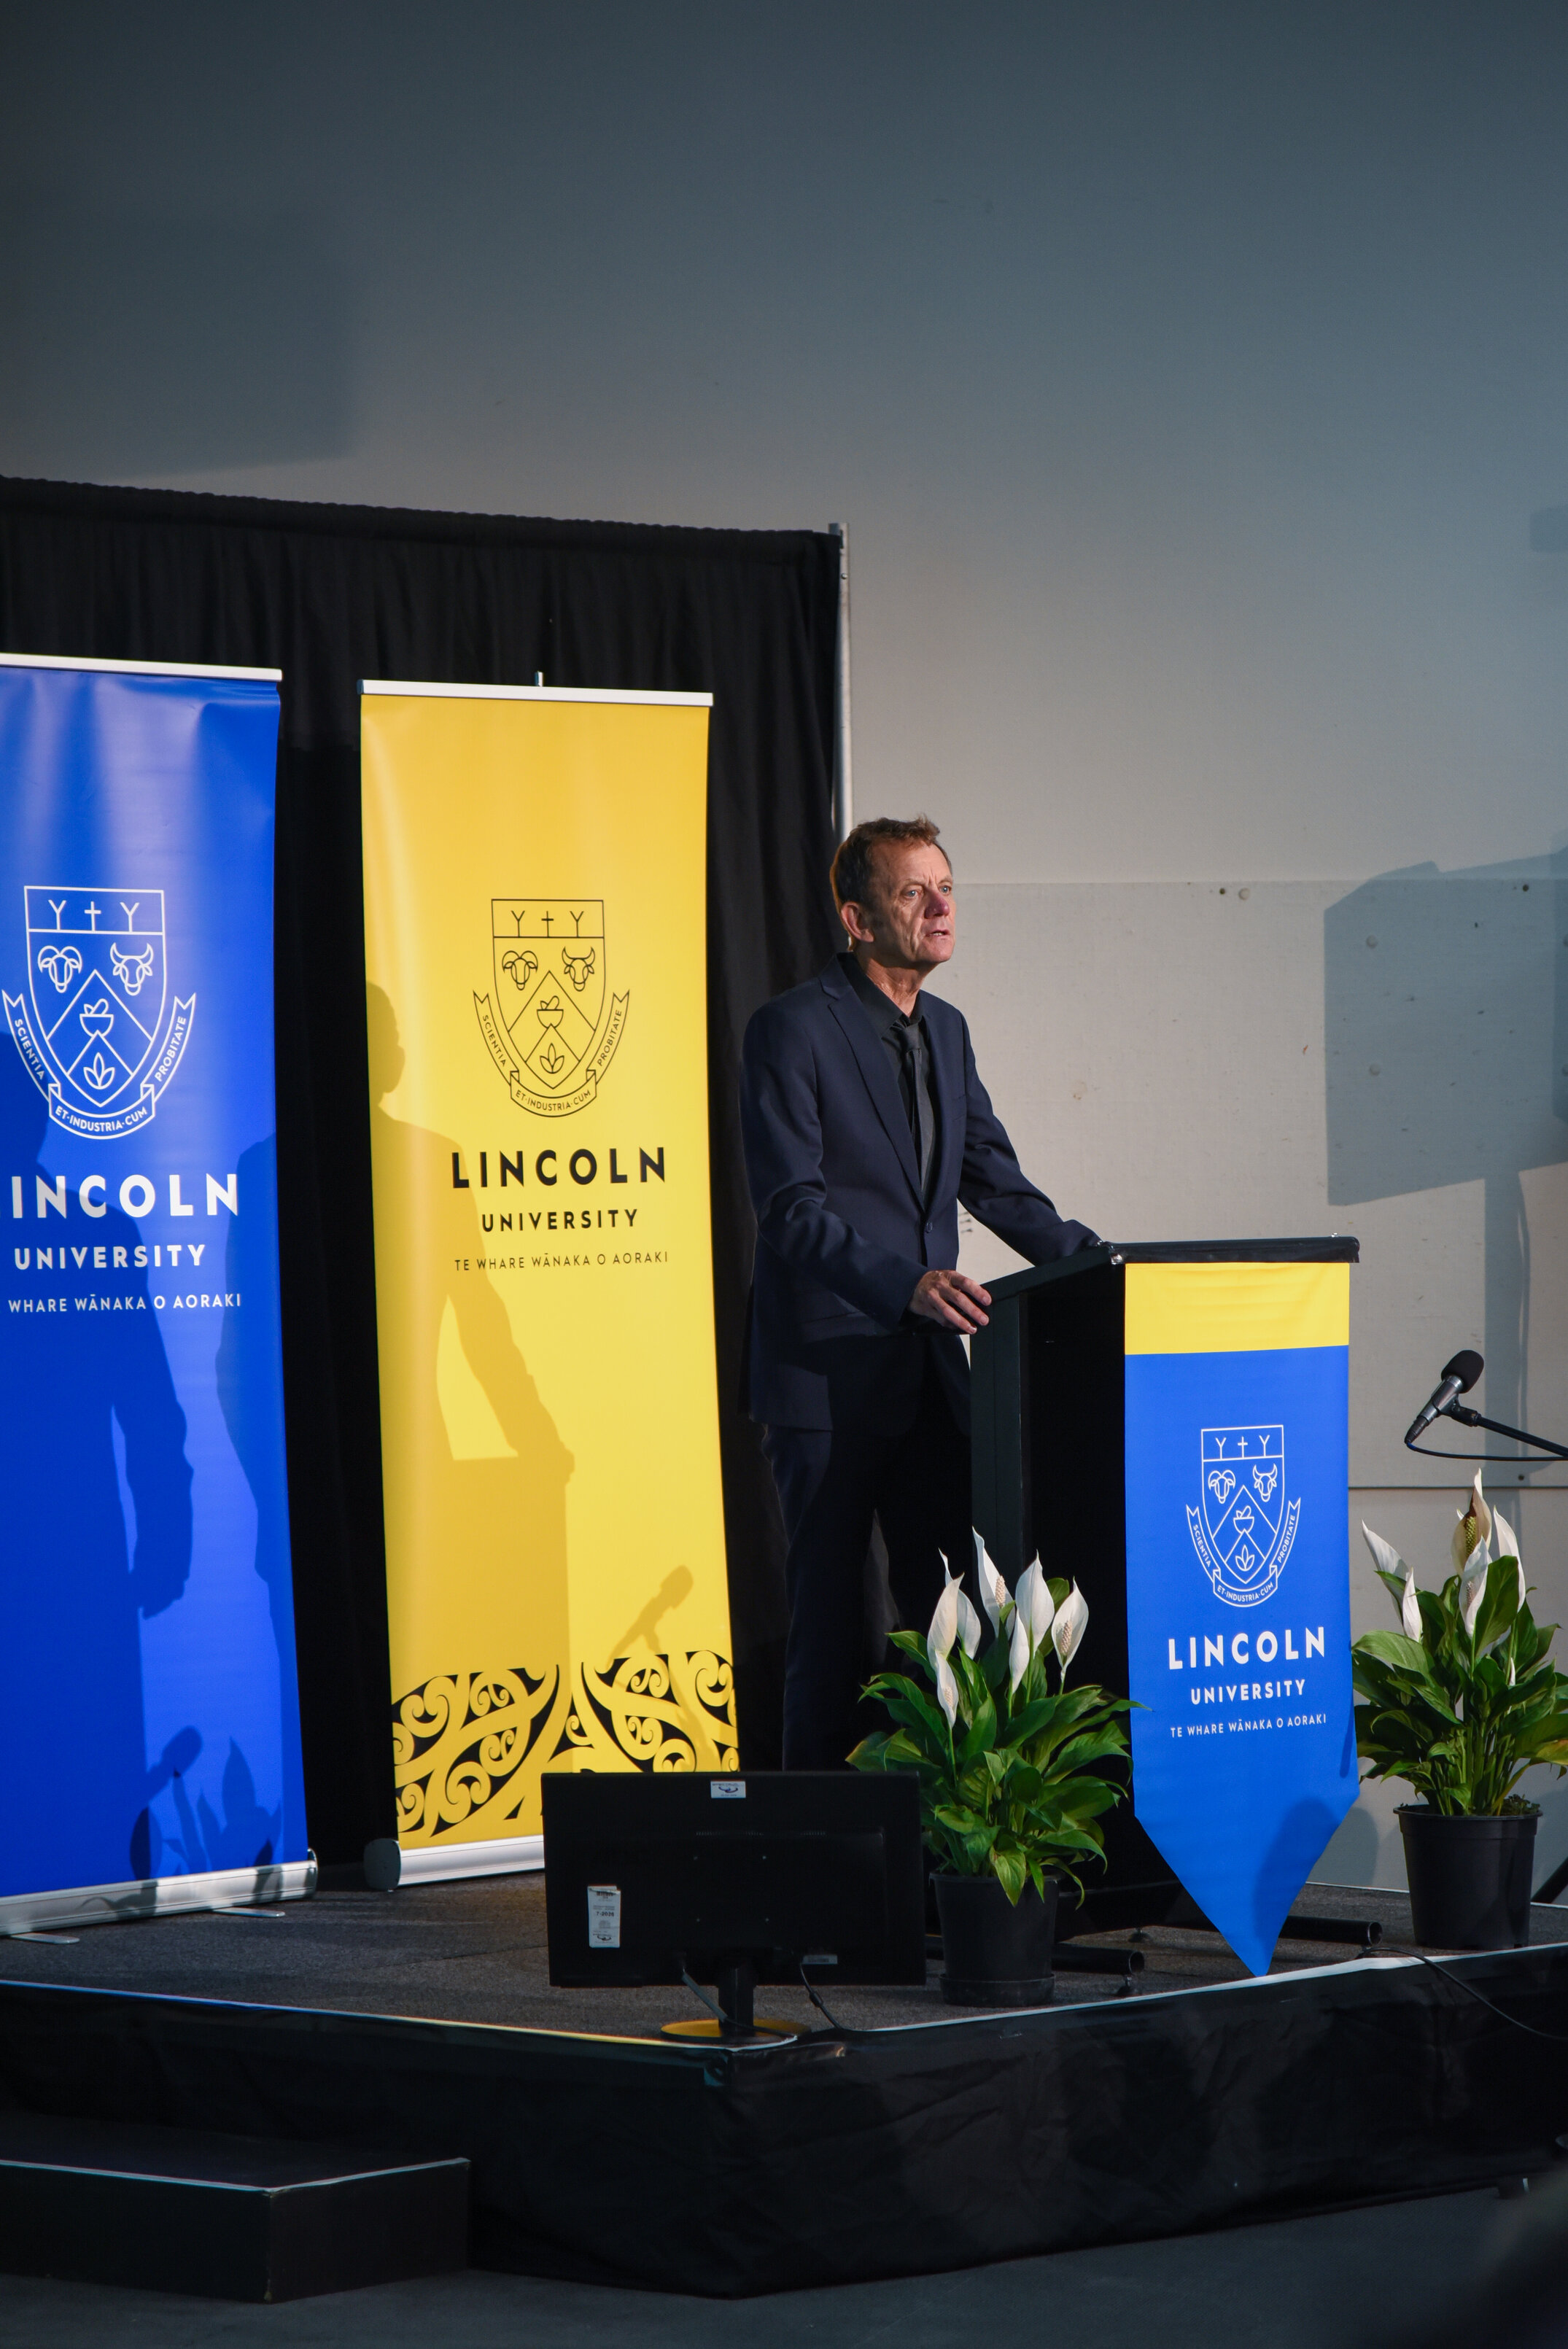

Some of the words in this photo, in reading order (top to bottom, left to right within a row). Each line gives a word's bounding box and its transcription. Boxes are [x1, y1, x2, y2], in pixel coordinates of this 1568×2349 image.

[15, 1019, 44, 1080] SCIENTIA
[155, 1016, 186, 1082] PROBITATE
[483, 1014, 506, 1067] SCIENTIA
[597, 1009, 622, 1066] PROBITATE
[451, 1147, 665, 1188] LINCOLN
[12, 1173, 238, 1219] INCOLN
[482, 1209, 637, 1232] UNIVERSITY
[15, 1244, 205, 1270] UNIVERSITY
[455, 1259, 469, 1270] TE
[476, 1257, 524, 1270] WHARE
[532, 1253, 590, 1267] WĀNAKA
[597, 1254, 605, 1265] O
[613, 1251, 667, 1265] AORAKI
[8, 1298, 67, 1313] WHARE
[75, 1294, 146, 1311] WĀNAKA
[154, 1296, 166, 1309] O
[174, 1293, 241, 1308] AORAKI
[1193, 1524, 1211, 1567] SCIENTIA
[1278, 1515, 1295, 1563] PROBITATE
[1168, 1626, 1324, 1669] LINCOLN
[1191, 1679, 1305, 1705] UNIVERSITY
[1171, 1727, 1182, 1738] TE
[1187, 1723, 1224, 1736] WHARE
[1229, 1719, 1272, 1732] WĀNAKA
[1276, 1717, 1284, 1728] O
[1287, 1714, 1327, 1728] AORAKI
